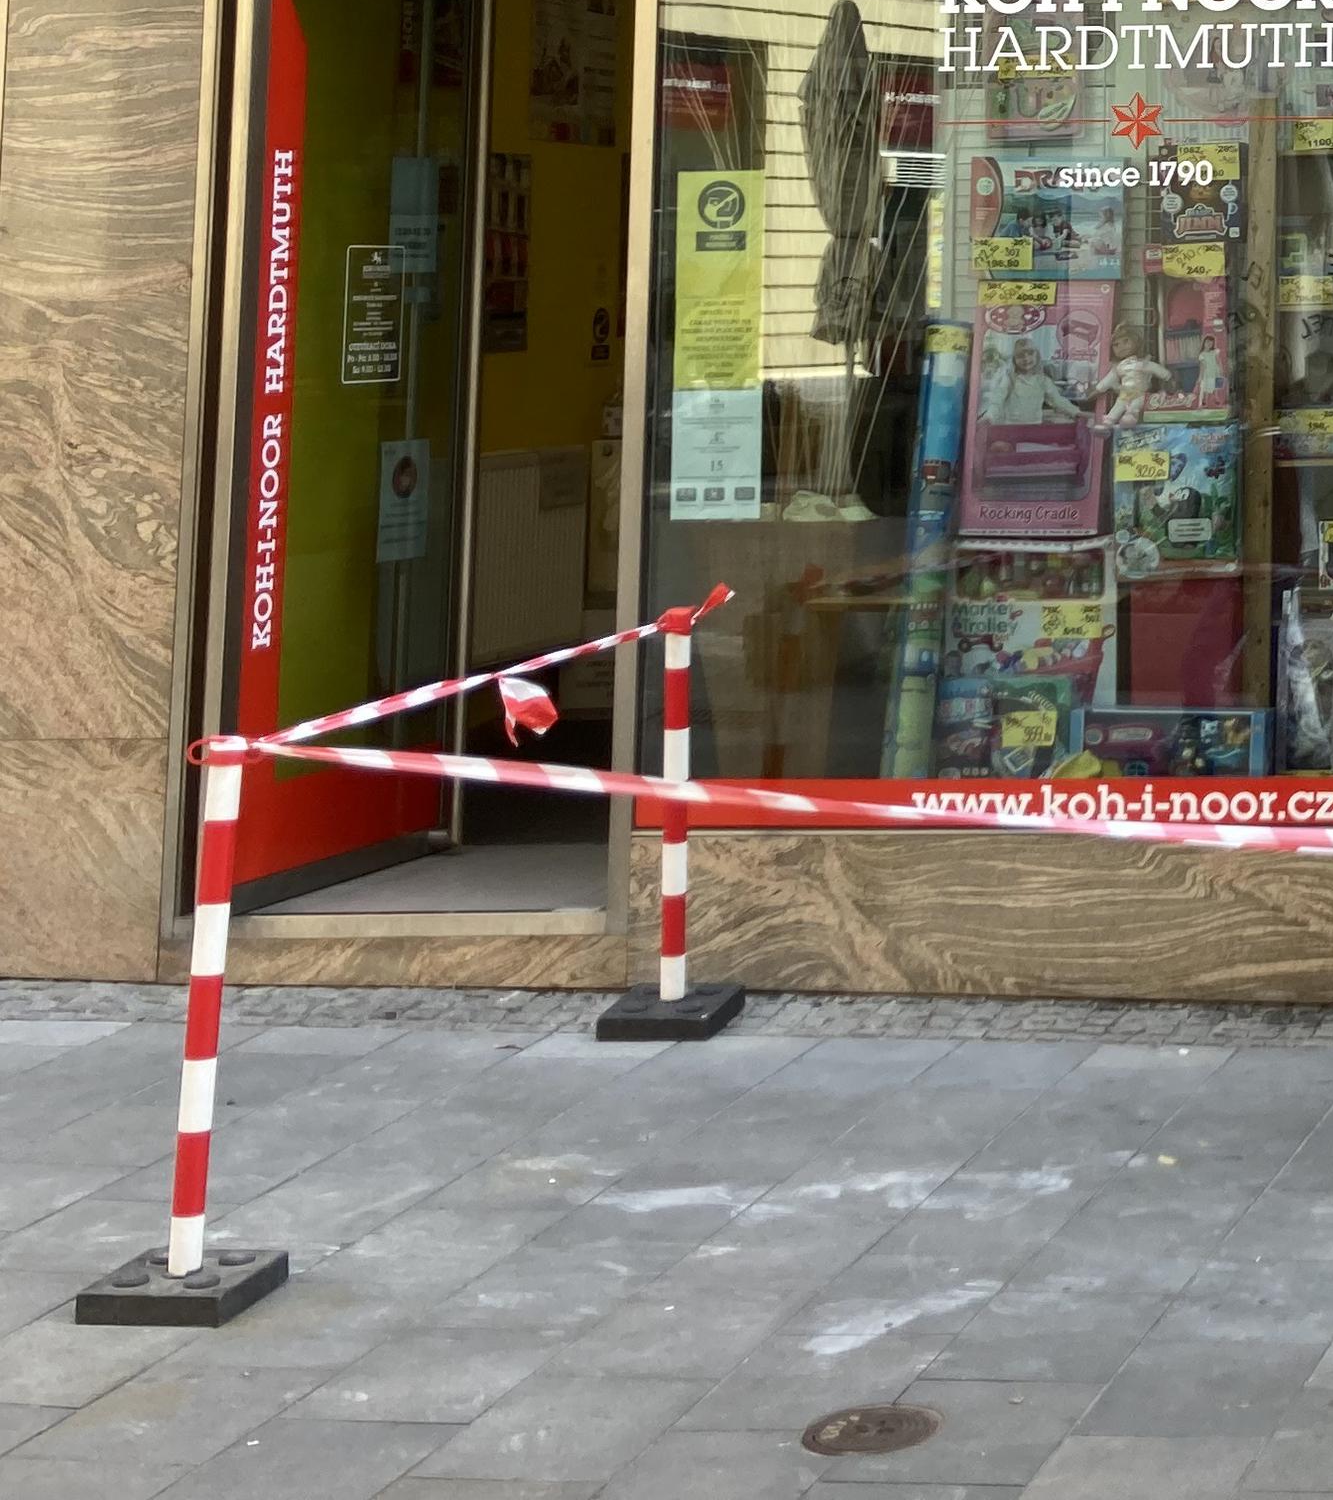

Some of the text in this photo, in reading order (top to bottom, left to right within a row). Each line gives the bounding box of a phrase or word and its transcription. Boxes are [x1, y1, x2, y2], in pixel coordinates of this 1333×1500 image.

[1059, 162, 1141, 188] since
[1148, 160, 1213, 186] 1790
[251, 149, 294, 650] KOH-I-NOOR HARDTMUTH
[979, 505, 1079, 524] Rocking Cradle
